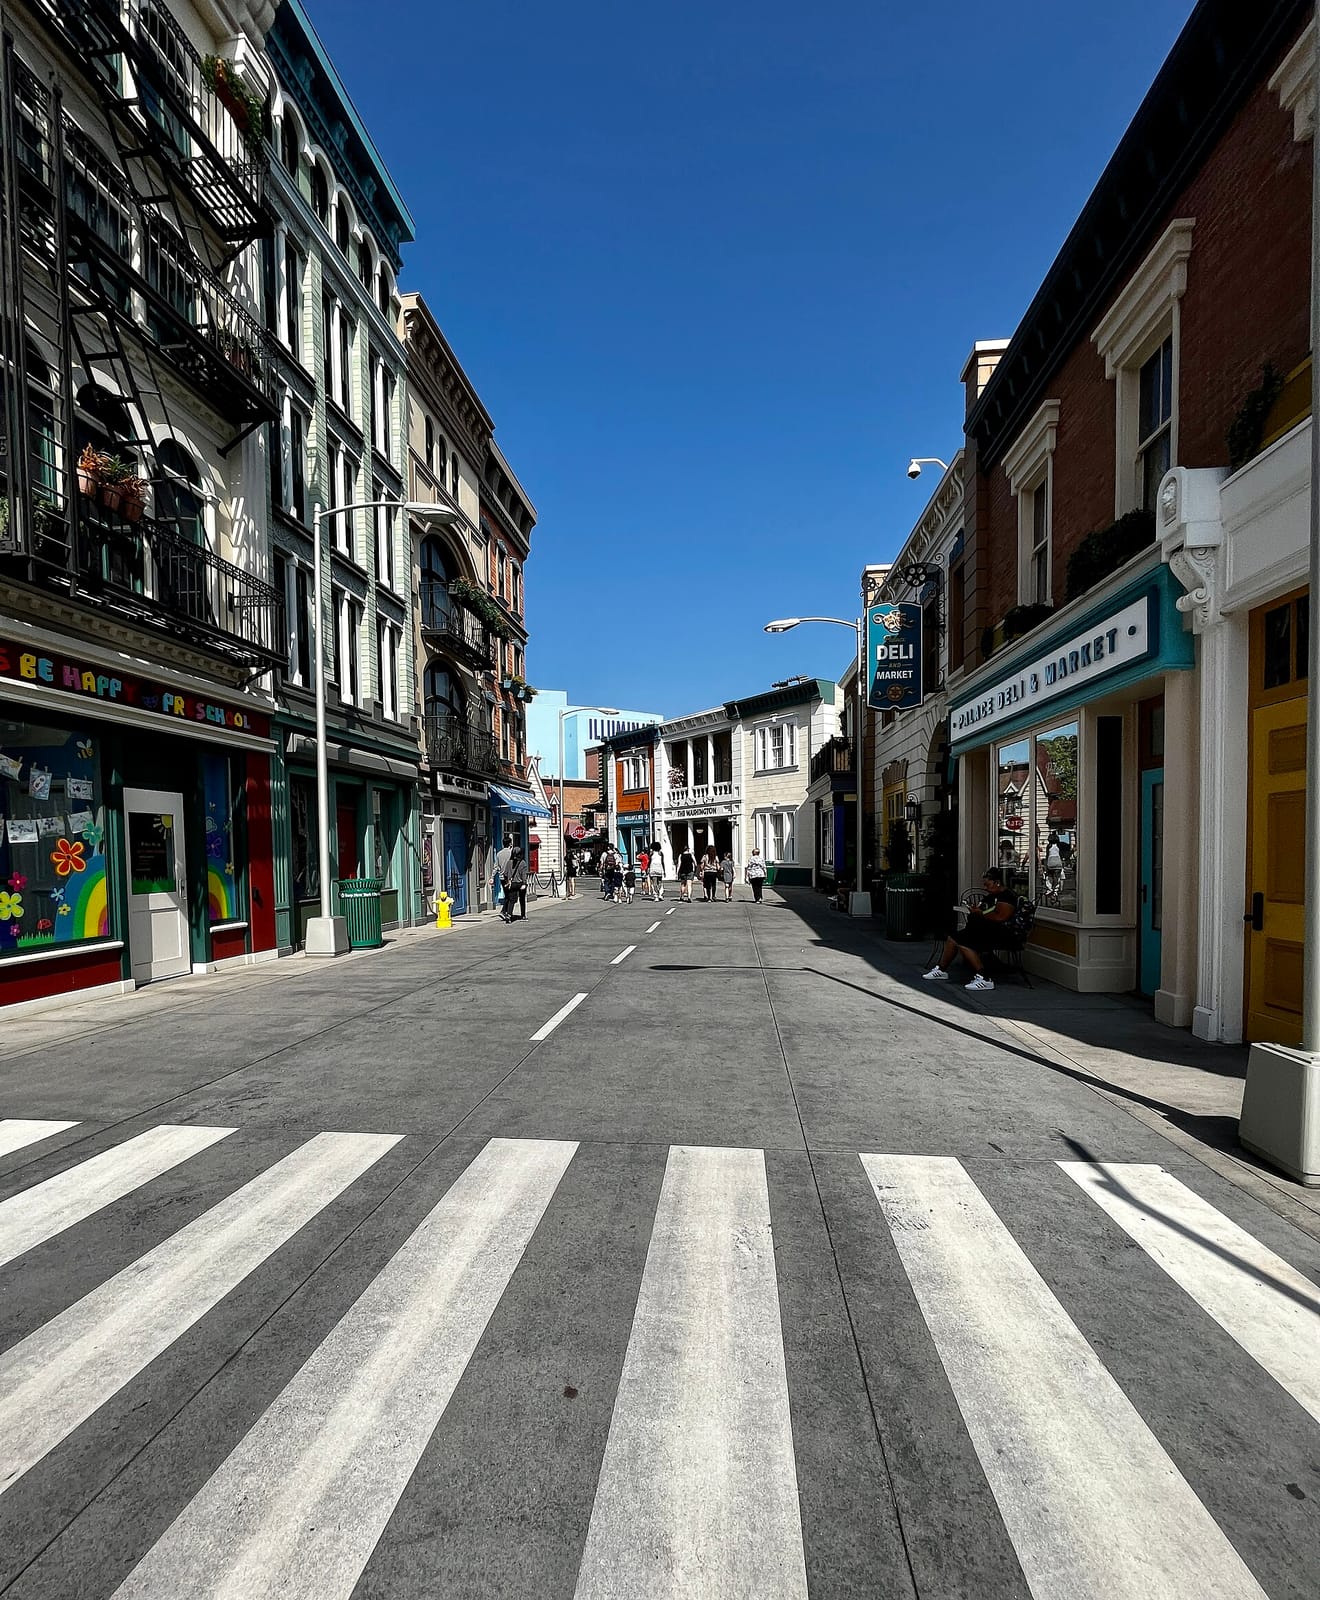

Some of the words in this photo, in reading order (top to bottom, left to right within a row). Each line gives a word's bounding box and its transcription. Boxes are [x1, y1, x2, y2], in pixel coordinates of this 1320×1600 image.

[876, 643, 914, 661] DELI
[19, 652, 54, 682] BE
[62, 664, 137, 704] HAPPY
[876, 669, 914, 680] MARKET
[958, 697, 993, 729] PALACE
[996, 679, 1025, 710] DELI
[1029, 673, 1039, 693] &
[1044, 627, 1118, 685] MARKET
[686, 807, 717, 816] WASHINGTON
